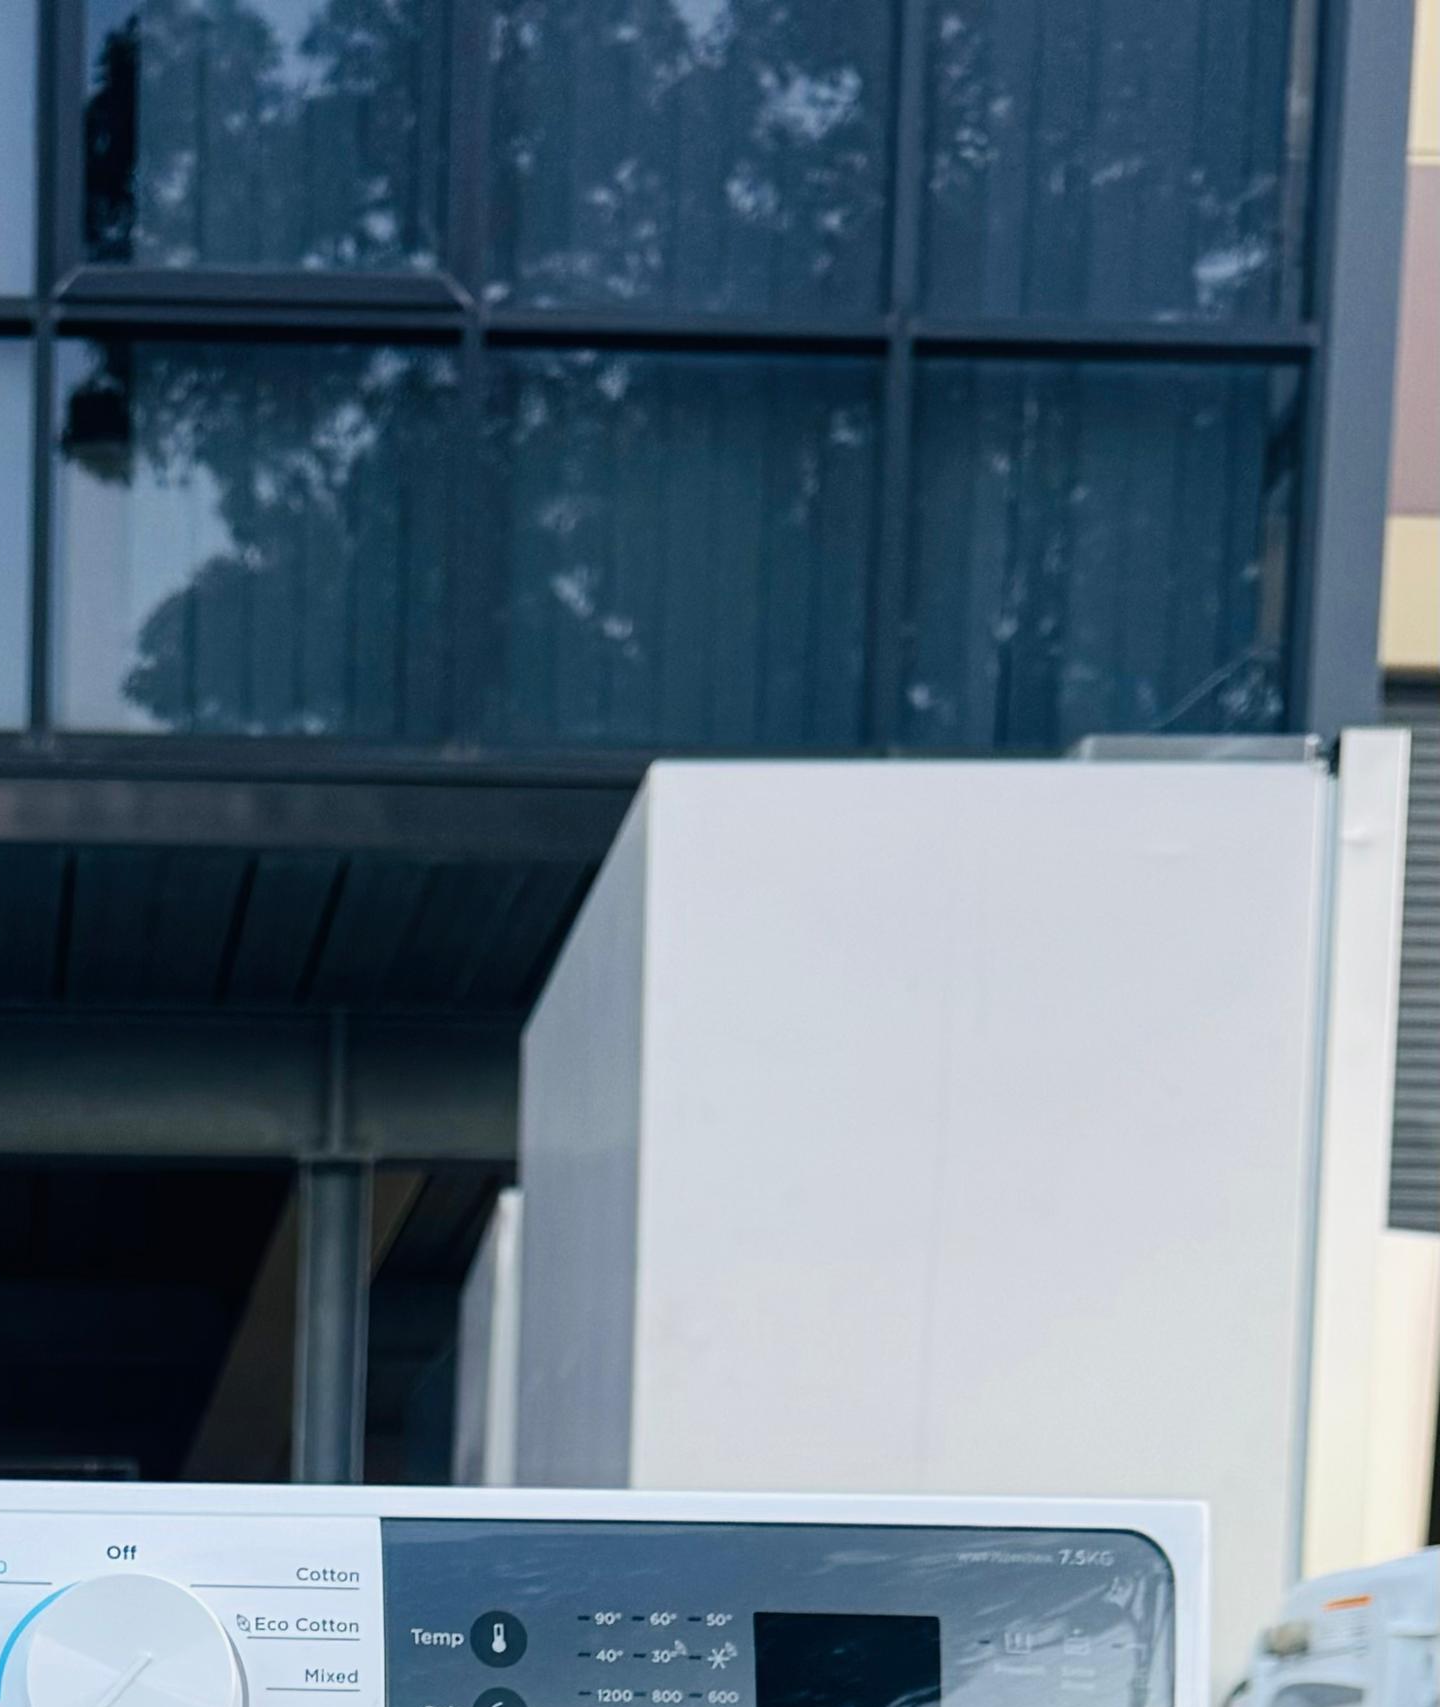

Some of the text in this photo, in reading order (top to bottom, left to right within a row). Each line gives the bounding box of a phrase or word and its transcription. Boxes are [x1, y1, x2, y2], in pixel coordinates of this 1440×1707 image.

[106, 1545, 137, 1560] Off
[1058, 1549, 1115, 1567] 7.5KG
[296, 1567, 360, 1583] Cotton
[255, 1617, 360, 1633] Eco Cotton
[411, 1628, 465, 1647] Temp
[304, 1668, 359, 1684] Mixed
[597, 1689, 633, 1702] 1200
[651, 1690, 683, 1704] 800
